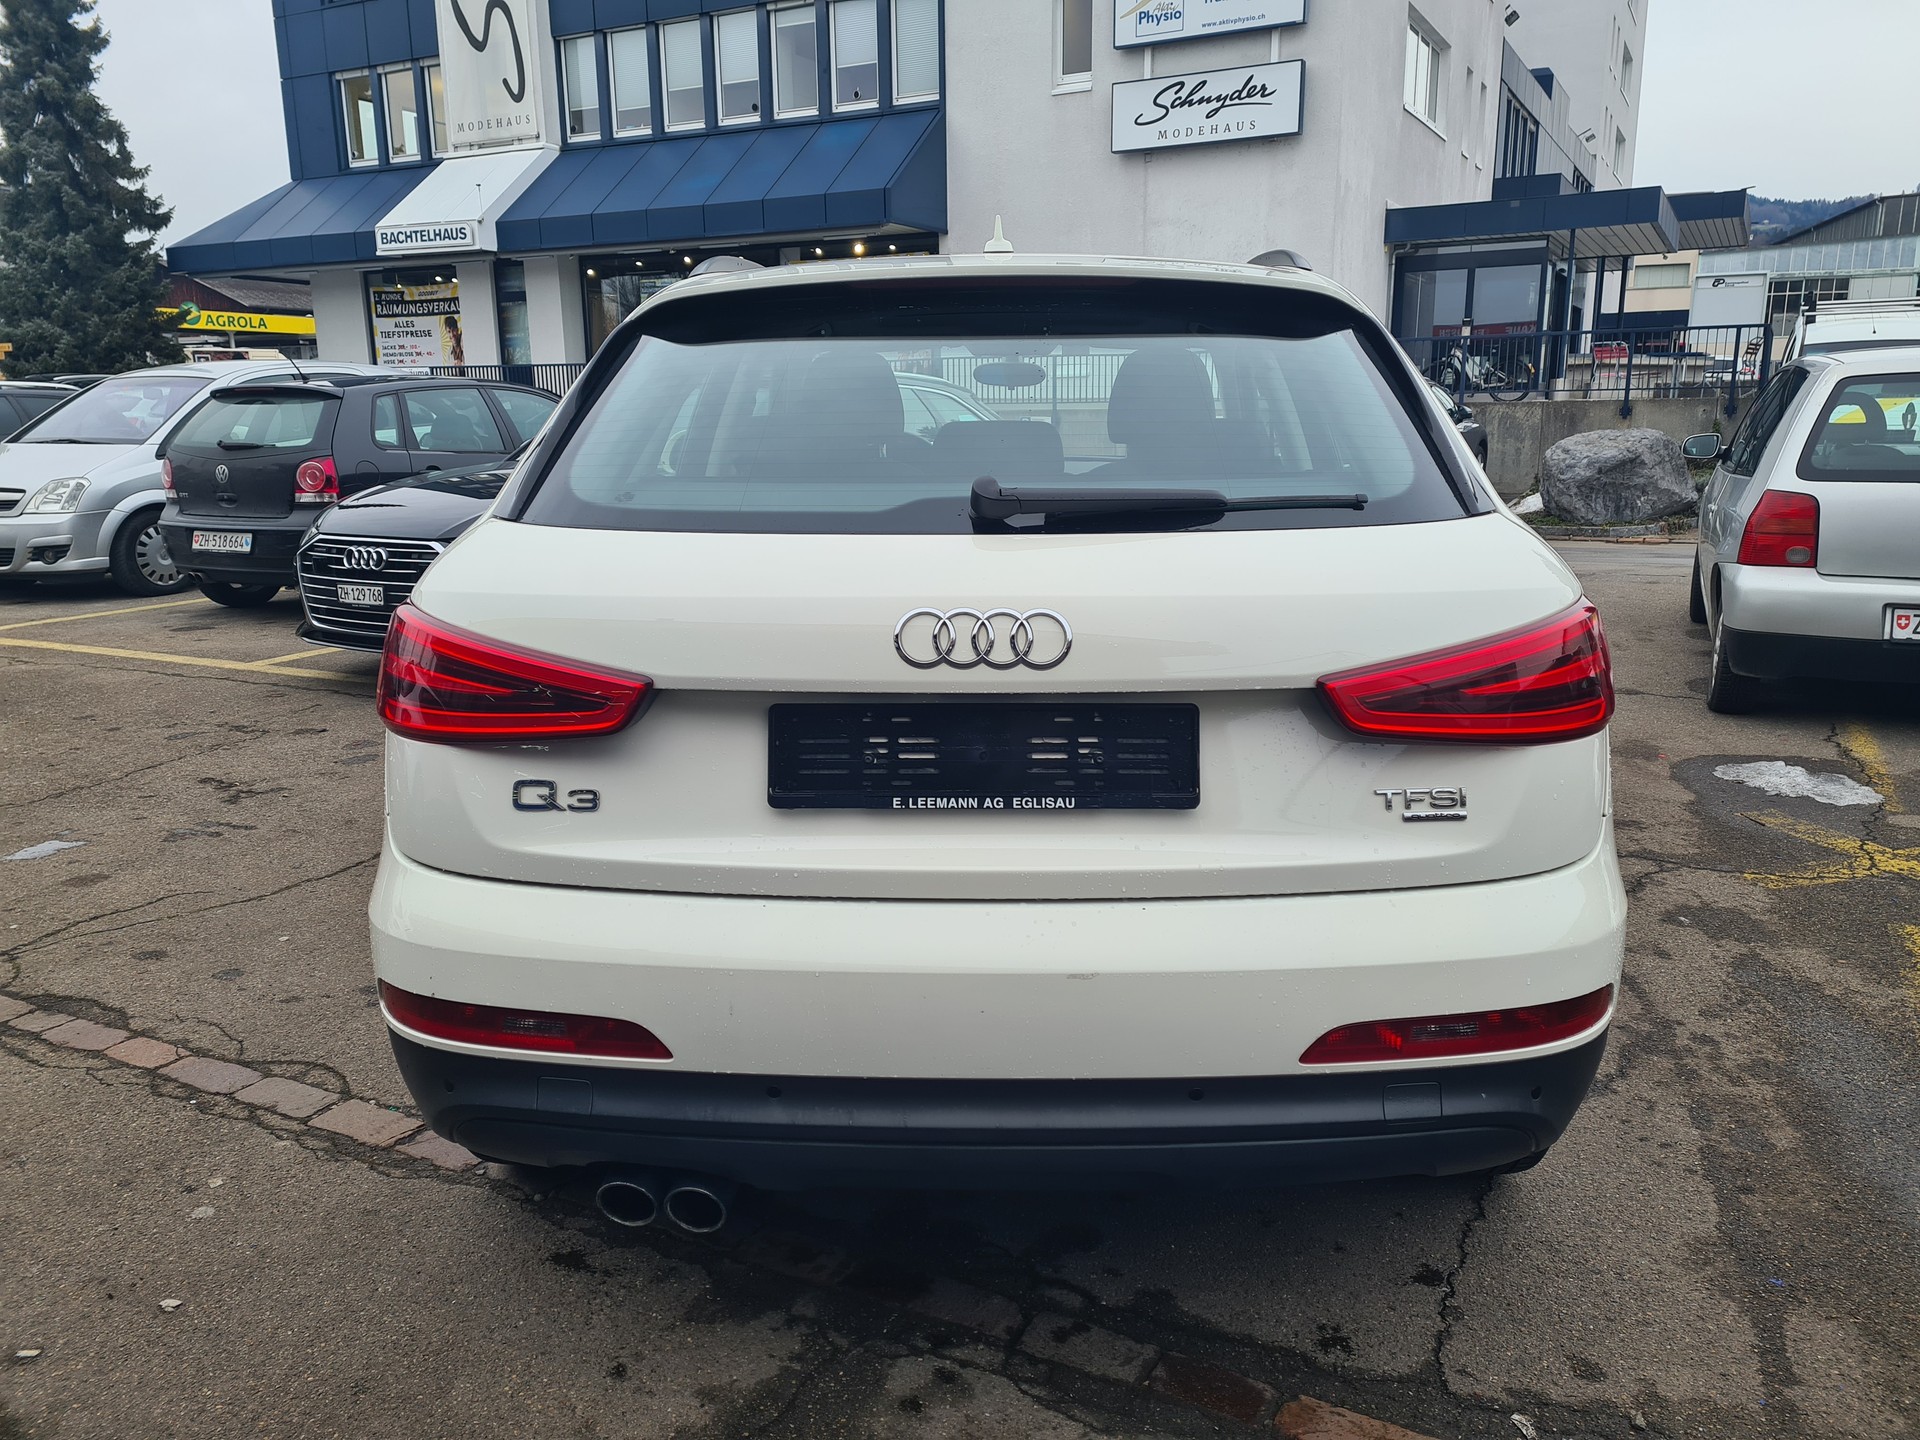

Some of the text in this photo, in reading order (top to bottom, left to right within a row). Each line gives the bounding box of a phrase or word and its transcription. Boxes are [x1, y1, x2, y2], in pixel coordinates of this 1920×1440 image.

[1152, 2, 1179, 13] Aktiv
[1138, 10, 1182, 26] Physio
[1201, 13, 1266, 28] www.aktivphysio.ch
[1134, 74, 1277, 126] Schnyder
[457, 114, 531, 133] MODEHAUS
[1157, 120, 1256, 140] MODEHAUS
[380, 227, 467, 245] BACHTELHAUS
[376, 300, 460, 315] RÄUMUNGSVERKAU
[205, 314, 268, 329] AGROLA
[394, 320, 415, 328] ALLES
[380, 329, 433, 339] TIEFSTPREISE
[512, 779, 600, 812] Q3
[892, 797, 1076, 809] E. LEEMANN AG EGLISAU
[1374, 786, 1467, 812] TFSI
